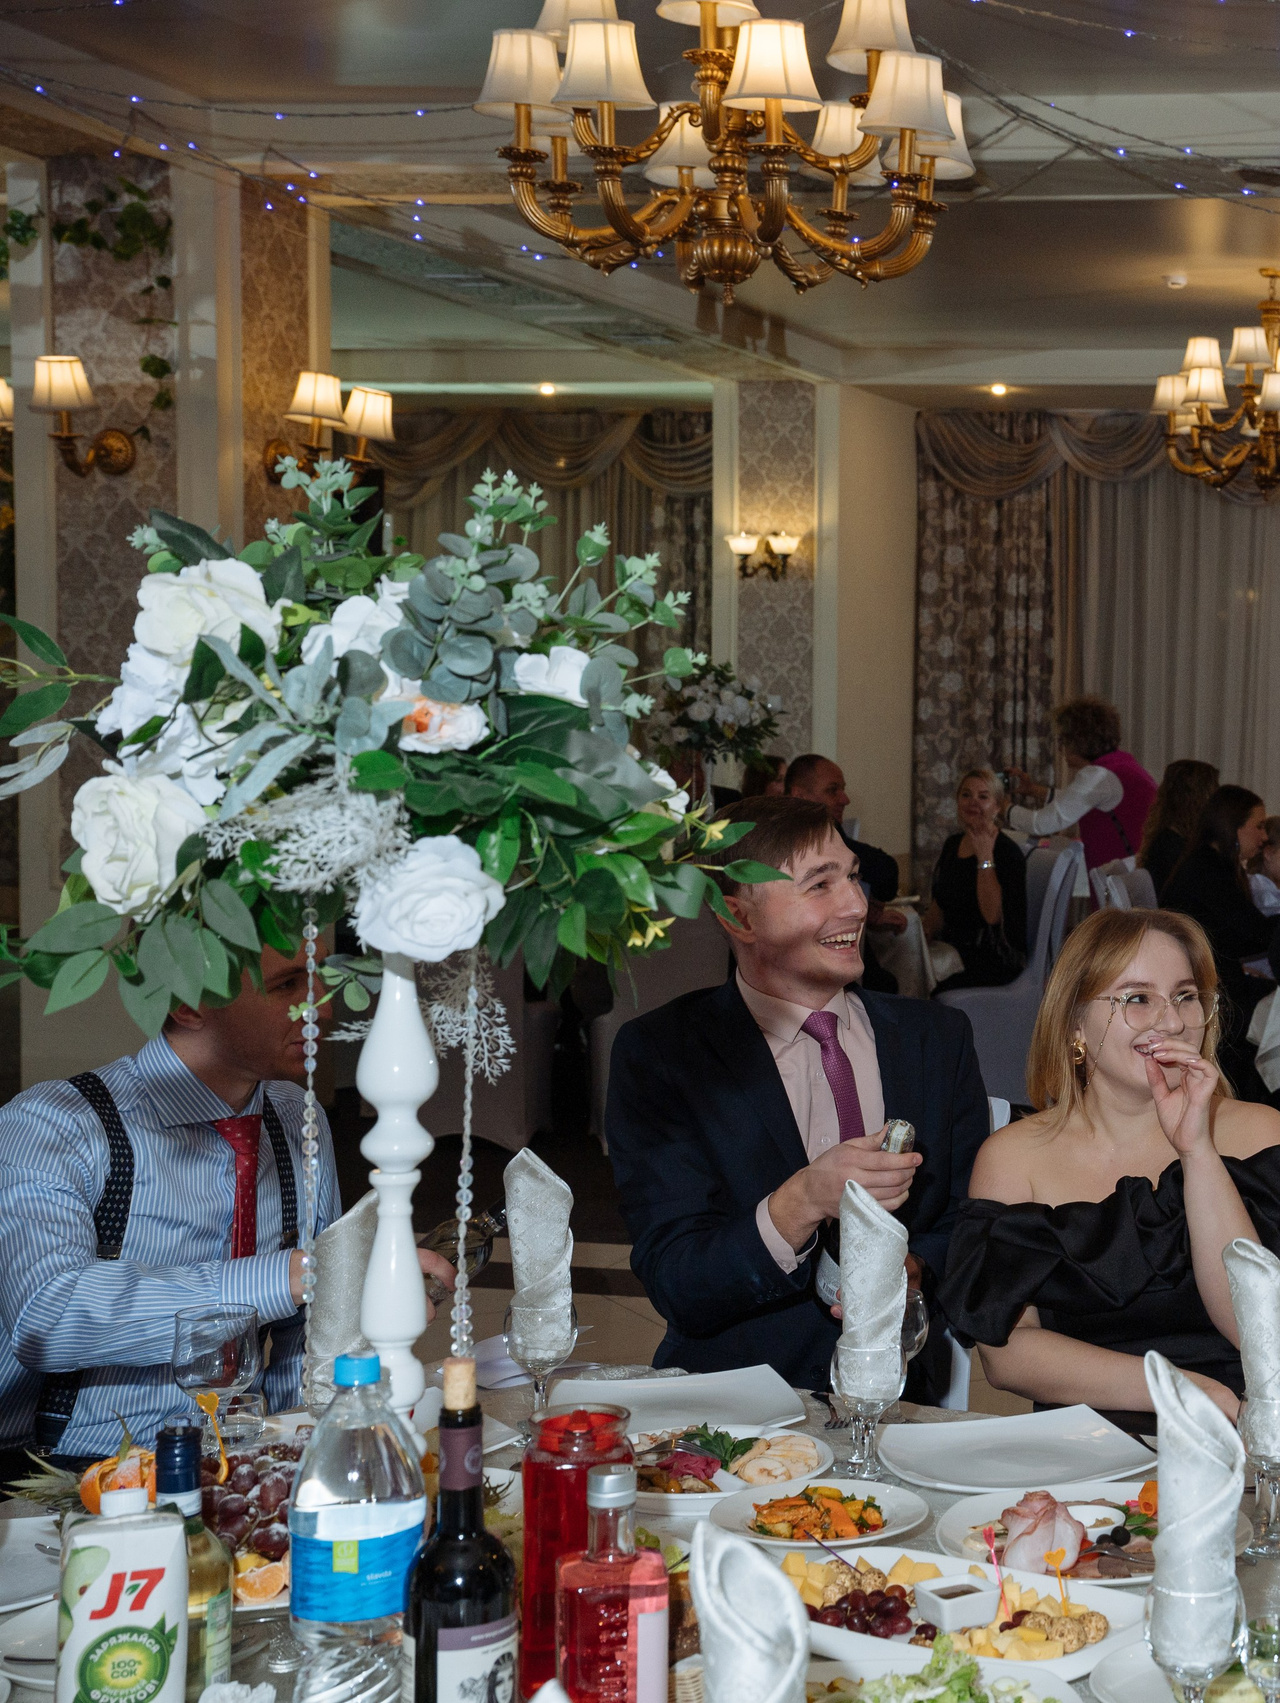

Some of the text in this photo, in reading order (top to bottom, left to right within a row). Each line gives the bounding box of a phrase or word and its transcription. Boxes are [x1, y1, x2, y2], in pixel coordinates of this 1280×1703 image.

[89, 1567, 166, 1620] J7
[89, 1632, 160, 1662] ЗАРЯЖАЙСЯ
[110, 1668, 137, 1680] СОК
